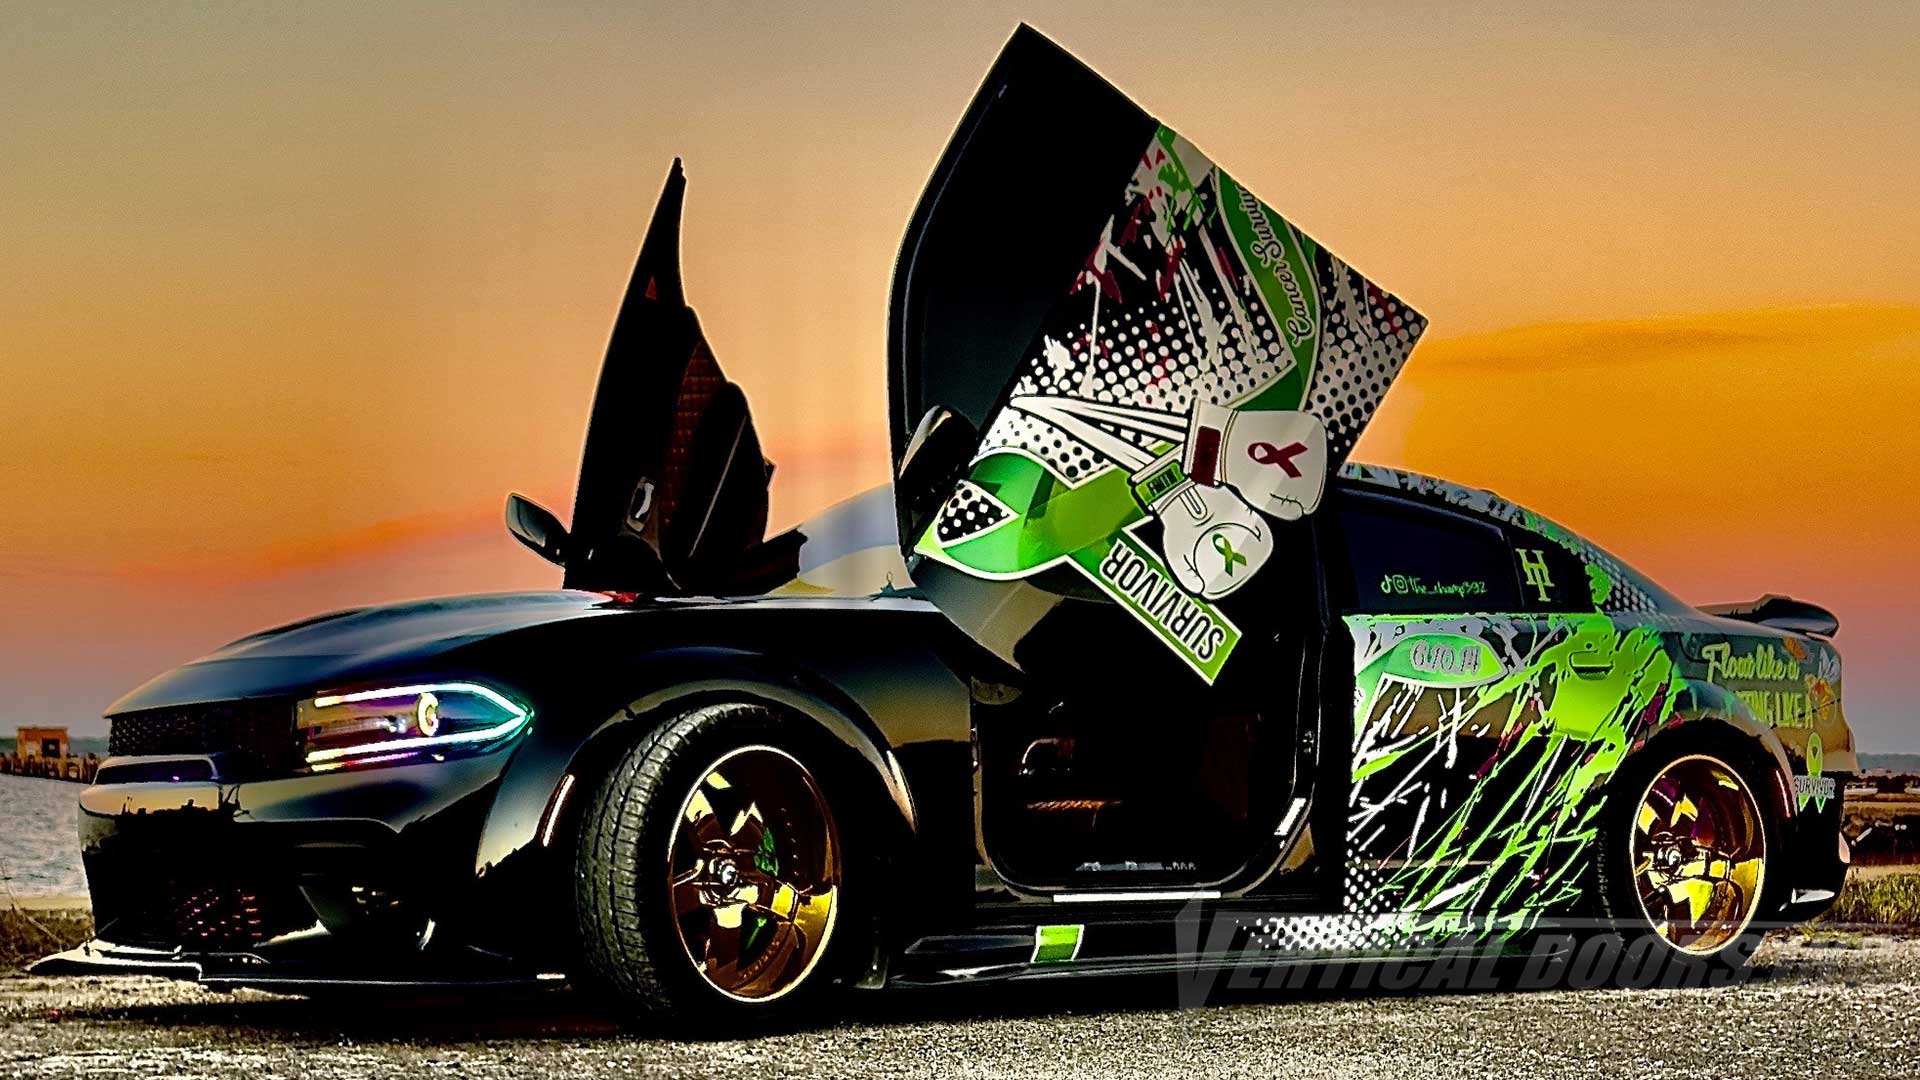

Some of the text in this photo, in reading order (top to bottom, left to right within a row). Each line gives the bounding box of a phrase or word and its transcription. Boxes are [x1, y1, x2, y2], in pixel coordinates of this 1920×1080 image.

[1275, 260, 1316, 347] Cancer
[1099, 538, 1224, 661] SURVIVOR
[1702, 641, 1800, 684] Float like a
